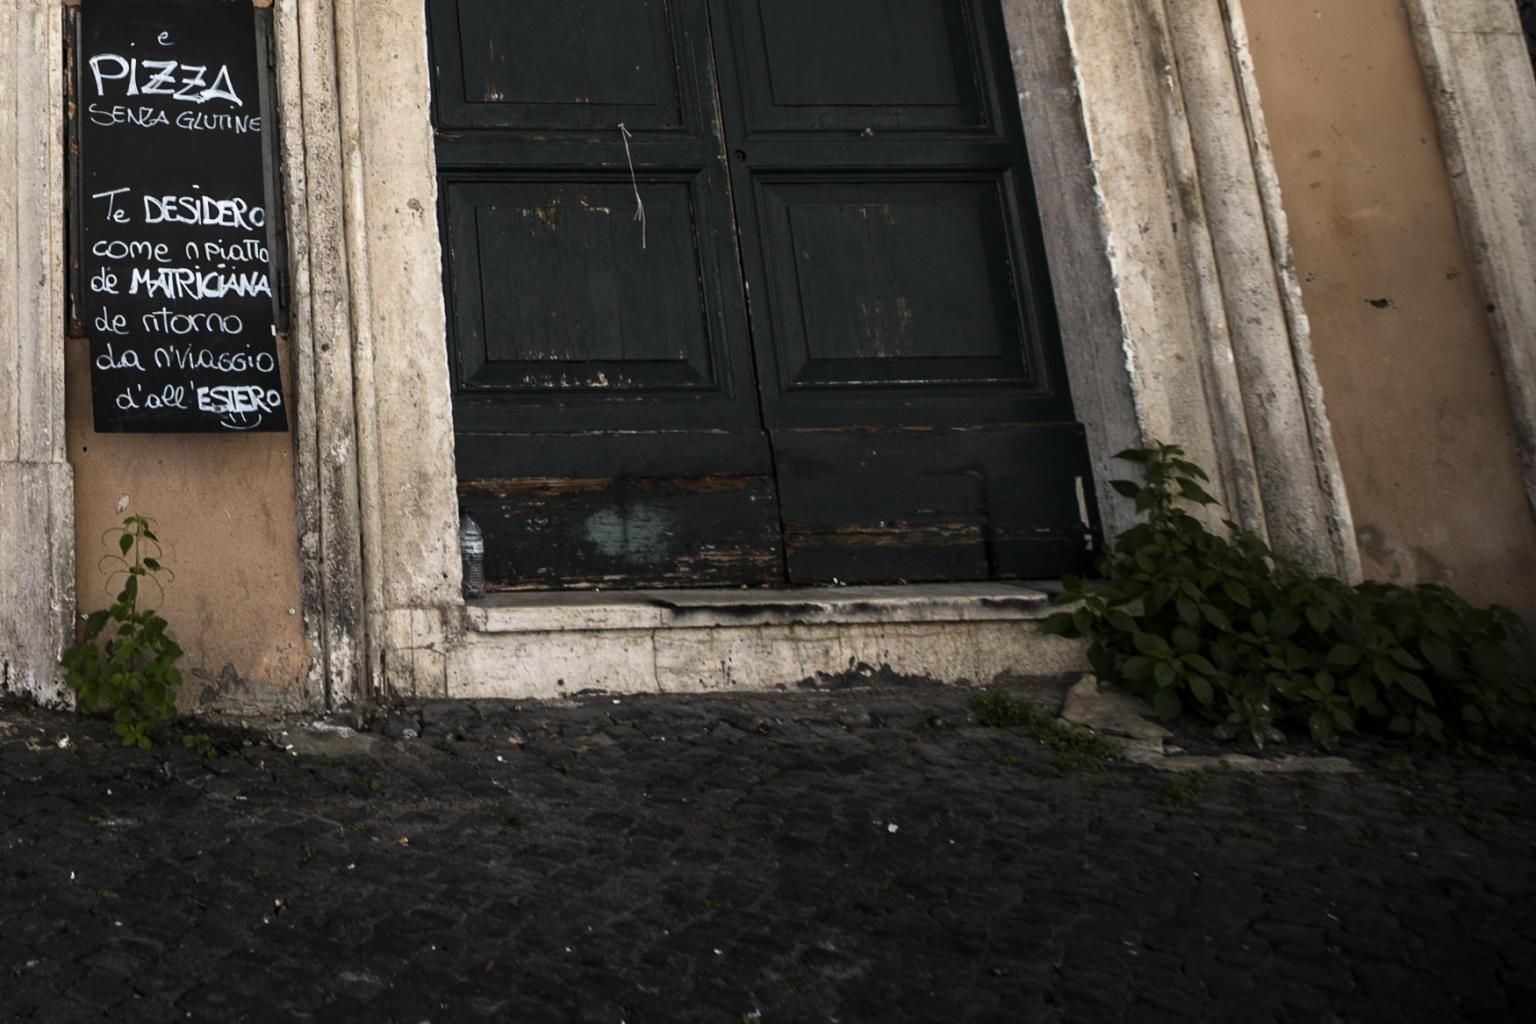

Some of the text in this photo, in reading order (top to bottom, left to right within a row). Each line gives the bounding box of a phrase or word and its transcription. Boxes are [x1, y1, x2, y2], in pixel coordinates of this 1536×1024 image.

[157, 31, 175, 46] e
[89, 42, 244, 107] PIZZA
[88, 103, 262, 135] SENZA GLUTINE
[92, 184, 265, 231] Te DESIDERO
[92, 240, 172, 263] come
[90, 263, 273, 301] de MATRICIANA
[94, 305, 130, 335] de
[96, 342, 146, 372] da
